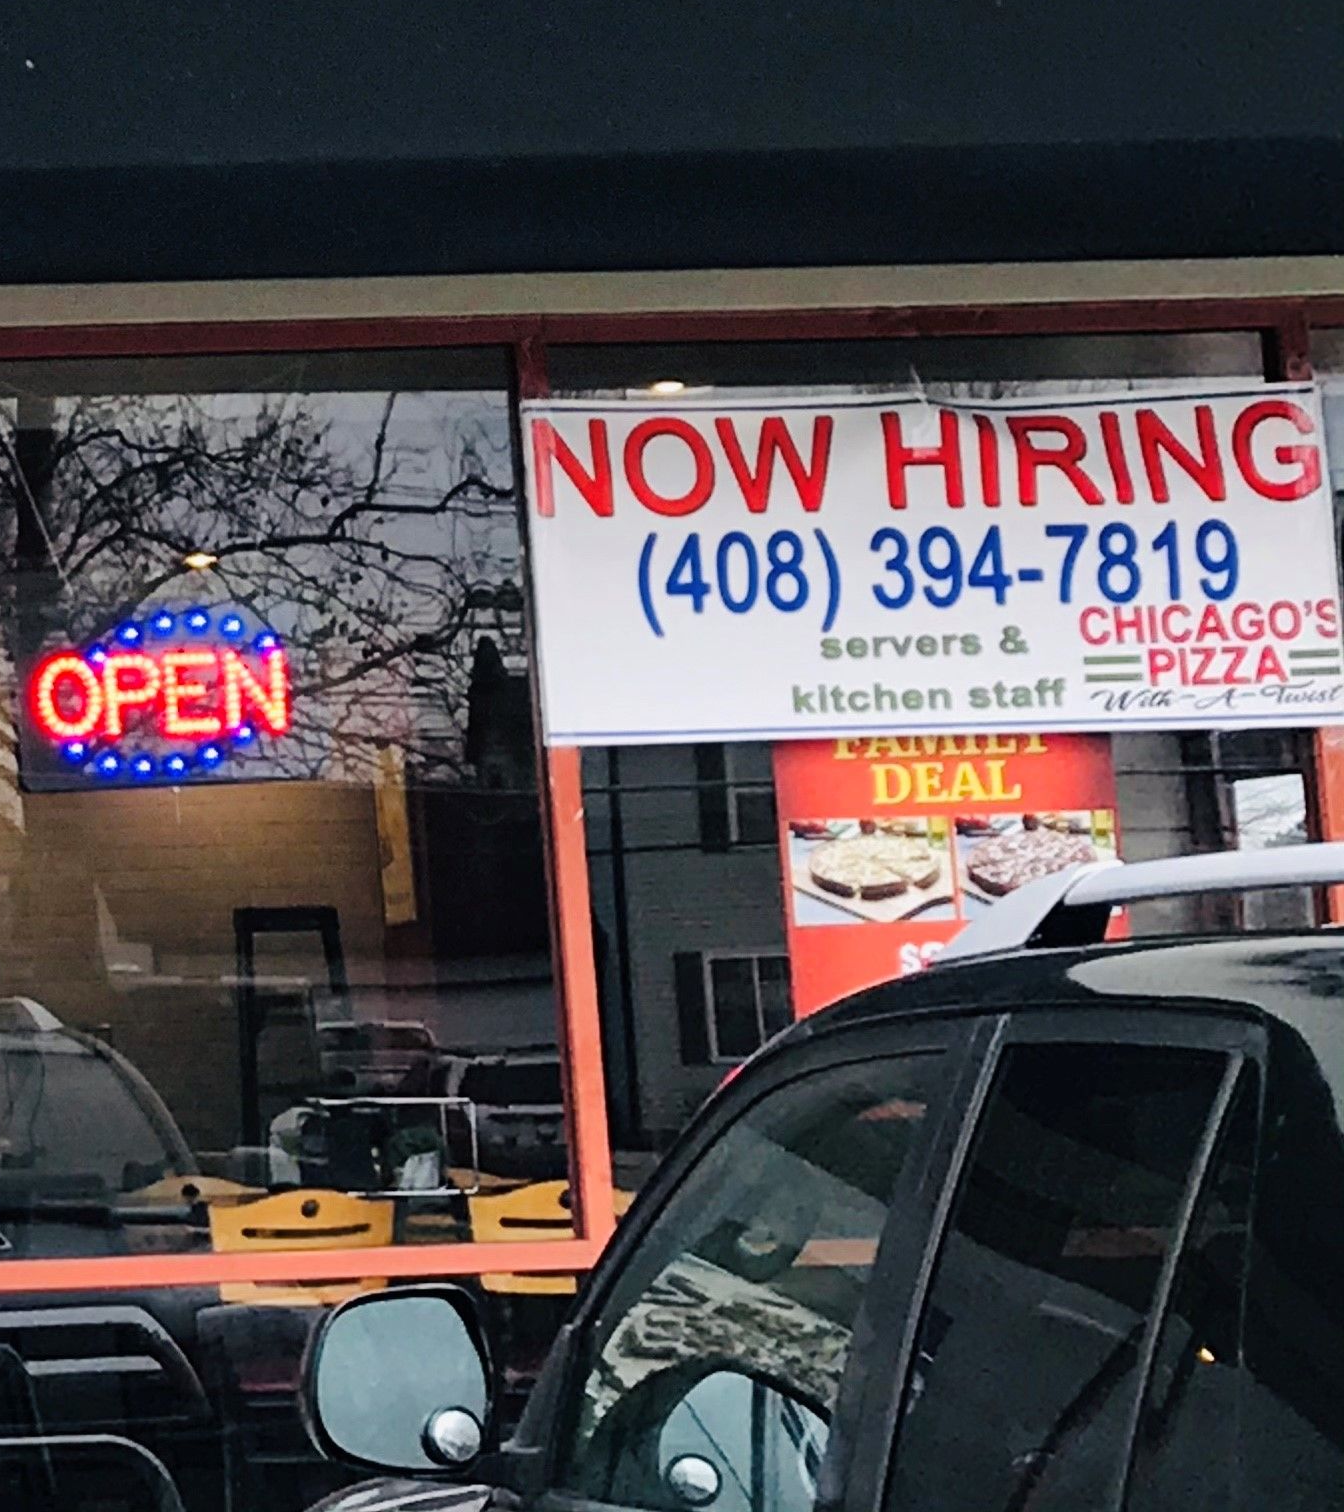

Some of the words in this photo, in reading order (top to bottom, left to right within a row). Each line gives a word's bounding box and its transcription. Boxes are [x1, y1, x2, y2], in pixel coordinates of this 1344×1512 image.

[531, 414, 834, 517] NOW
[880, 399, 1323, 510] HIRING
[637, 528, 841, 637] (408)
[869, 518, 1239, 609] 394-7819
[819, 631, 982, 661] servers
[999, 625, 1030, 655] &
[1079, 598, 1339, 647] CHICAGO'S
[1148, 644, 1289, 687] PIZZA
[30, 648, 290, 739] OPEN
[791, 683, 953, 715] kitchen
[968, 677, 1068, 711] staff
[870, 759, 1022, 806] DEAL
